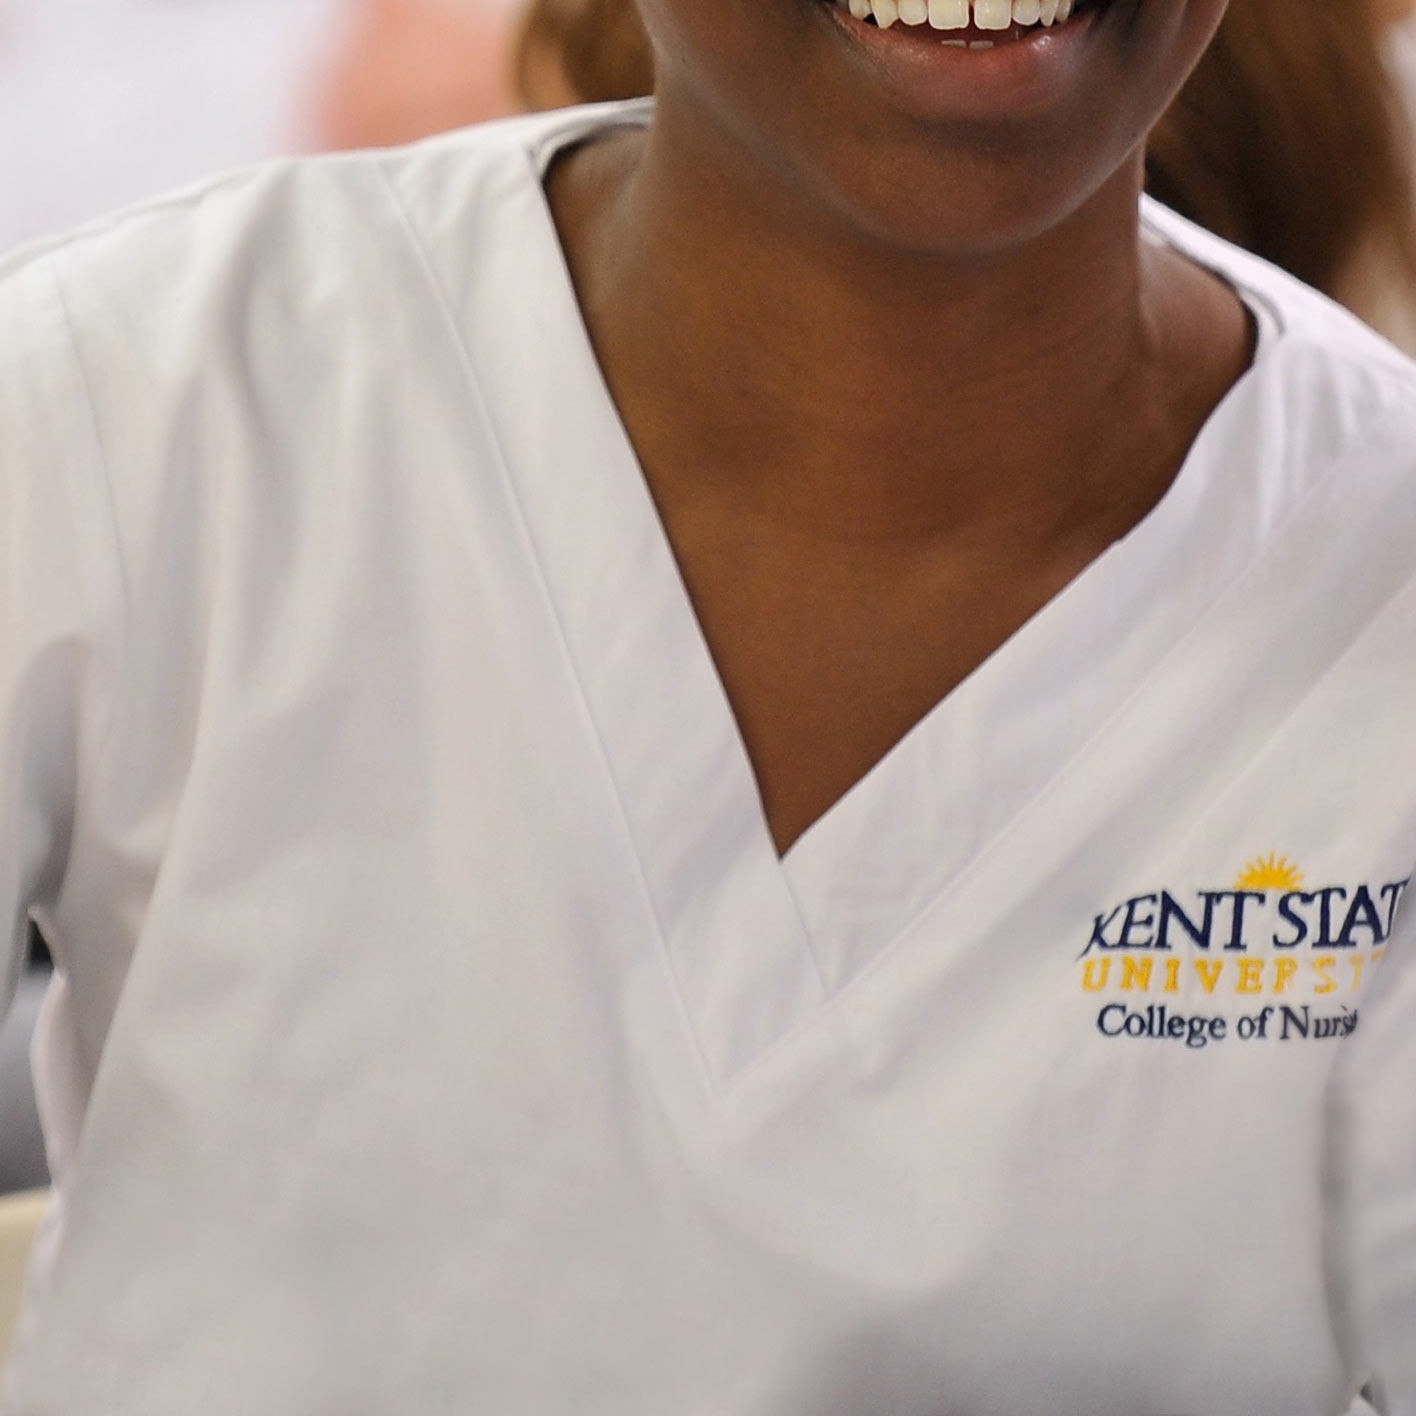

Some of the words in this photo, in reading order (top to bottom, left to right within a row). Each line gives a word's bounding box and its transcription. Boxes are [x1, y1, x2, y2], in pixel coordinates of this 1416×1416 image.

[1077, 890, 1266, 961] KENT
[1097, 1003, 1227, 1048] College
[1237, 1006, 1275, 1039] of
